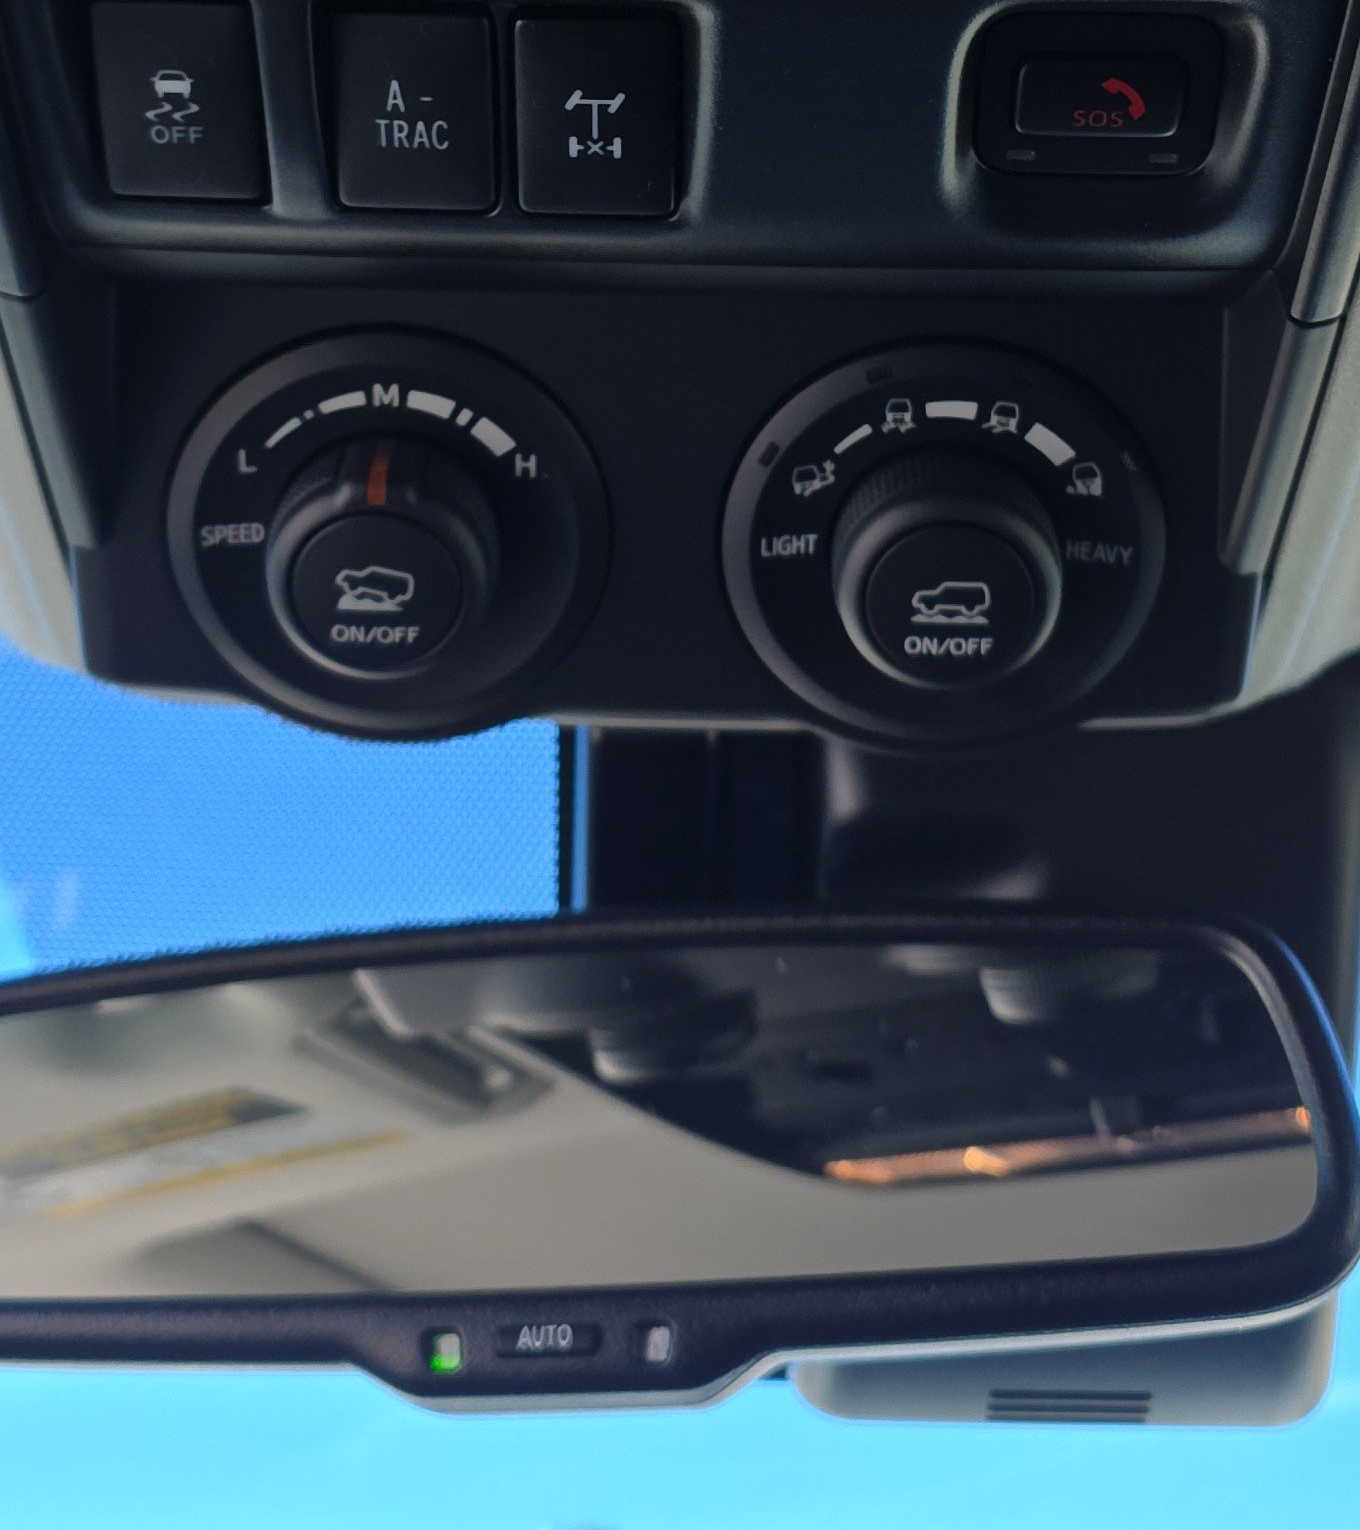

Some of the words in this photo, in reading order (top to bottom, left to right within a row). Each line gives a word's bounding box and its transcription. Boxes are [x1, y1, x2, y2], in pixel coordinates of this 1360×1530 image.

[1074, 111, 1123, 127] SOS
[150, 125, 202, 144] OFF
[376, 119, 448, 149] TRAC
[373, 384, 399, 406] M
[238, 449, 257, 473] L
[516, 453, 536, 477] H
[201, 523, 264, 546] SPEED
[761, 534, 817, 557] LIGHT
[1067, 542, 1133, 566] HEAVY
[331, 624, 419, 643] ON/OFF
[904, 636, 992, 655] ON/OFF
[516, 1324, 572, 1350] AUTO
